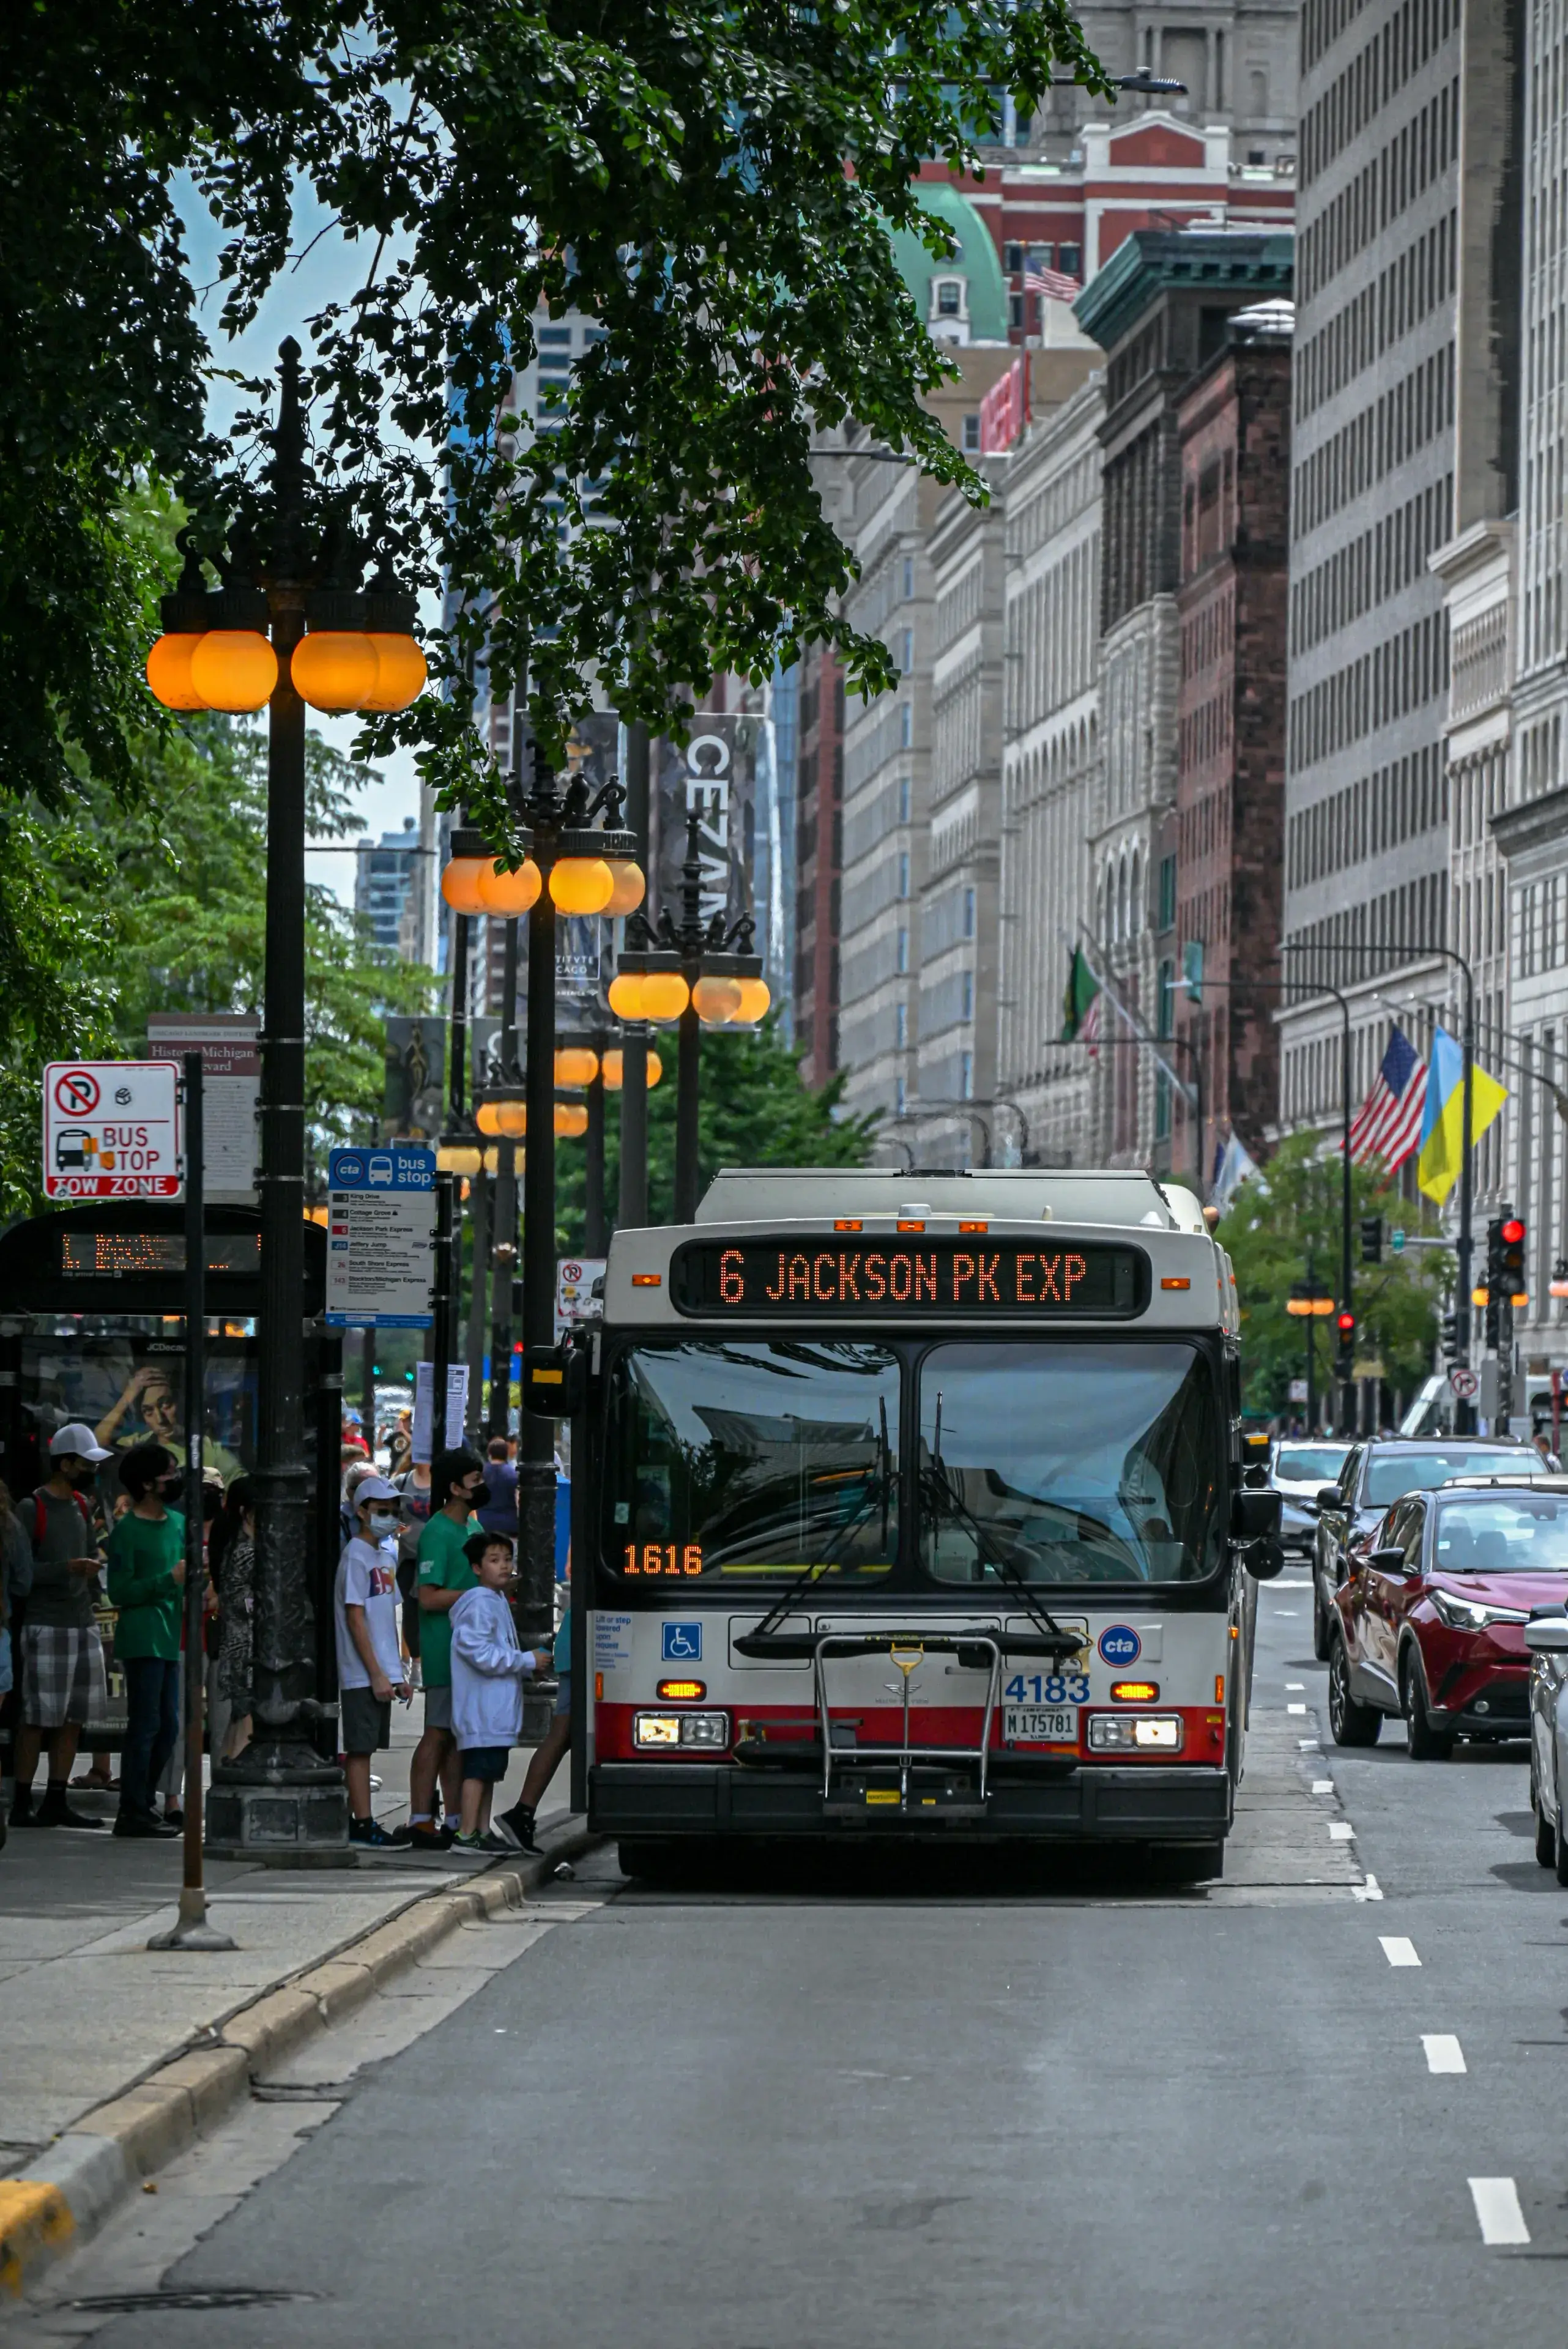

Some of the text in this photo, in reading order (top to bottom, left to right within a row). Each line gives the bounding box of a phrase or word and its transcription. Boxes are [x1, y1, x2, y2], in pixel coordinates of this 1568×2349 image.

[686, 734, 730, 932] CEZAN
[554, 955, 593, 965] TITVTE
[555, 965, 587, 974] CAGO
[201, 1046, 255, 1060] Michigan
[103, 1127, 149, 1148] BUS
[340, 1165, 360, 1174] cta
[398, 1156, 426, 1170] bus
[54, 1177, 167, 1194] TOW ZONE
[398, 1170, 431, 1187] stop
[720, 1250, 1087, 1303] 6 JACKSON PK EXP
[146, 1343, 187, 1351] JCDecau
[624, 1545, 702, 1575] 1616
[615, 1616, 631, 1625] step
[1105, 1638, 1134, 1653] cta
[1005, 1675, 1090, 1704] 4183
[1008, 1715, 1073, 1733] M 175781
